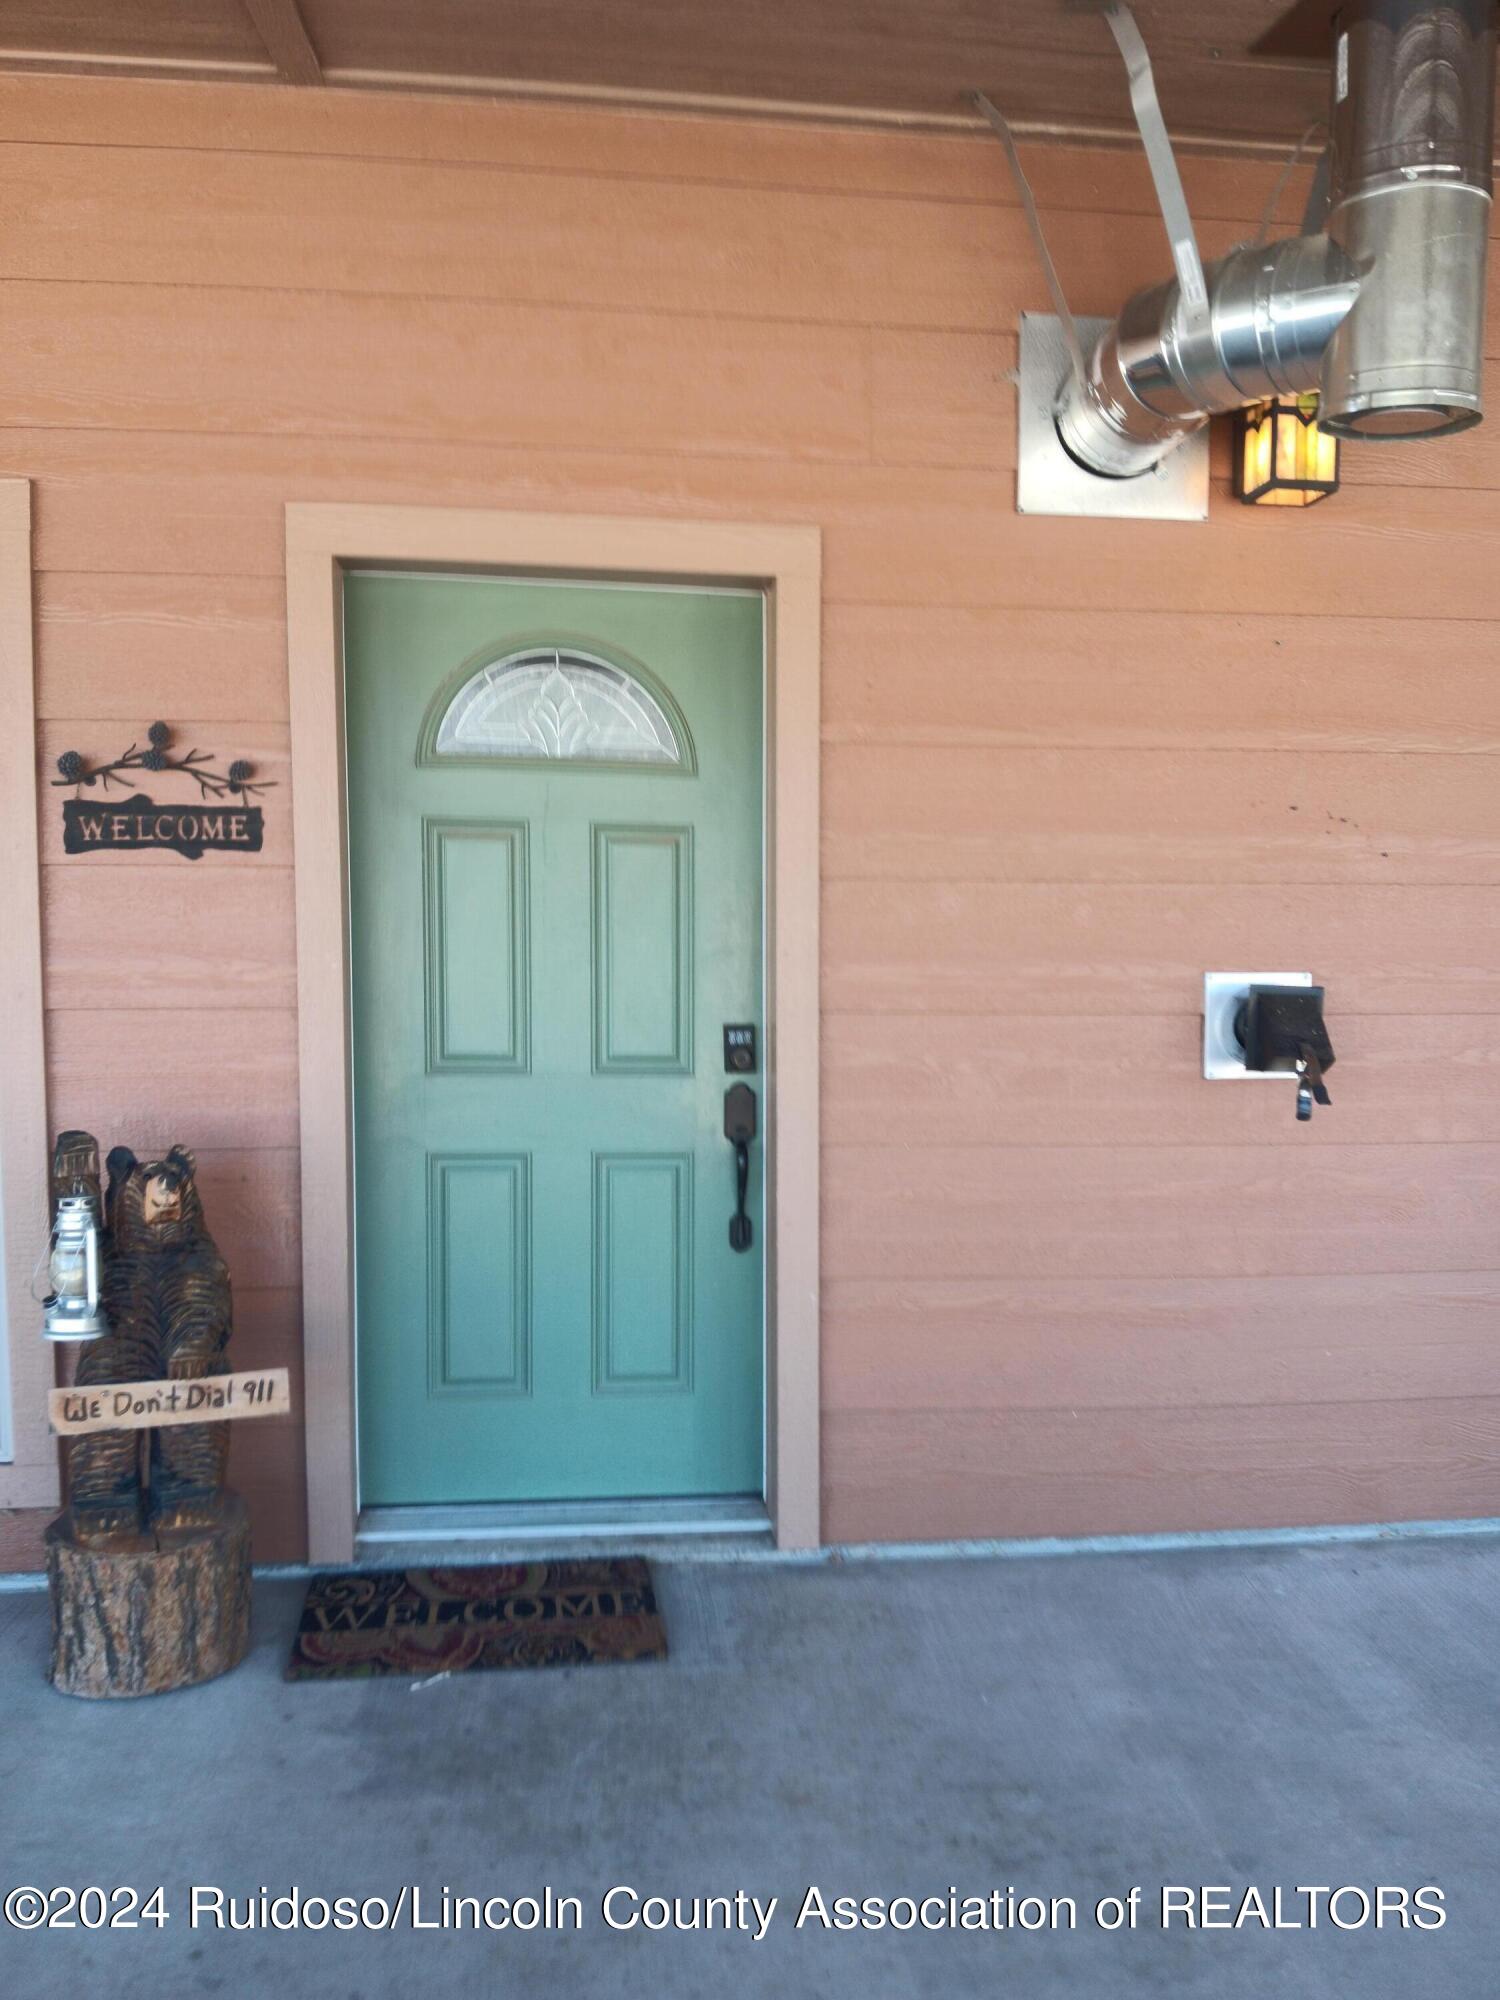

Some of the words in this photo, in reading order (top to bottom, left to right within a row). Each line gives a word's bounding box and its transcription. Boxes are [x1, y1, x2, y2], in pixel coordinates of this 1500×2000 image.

[78, 813, 250, 841] WELCOME
[113, 1386, 181, 1417] Don't
[186, 1380, 232, 1409] Dial
[243, 1379, 274, 1402] 911
[312, 1590, 646, 1631] WELCOME
